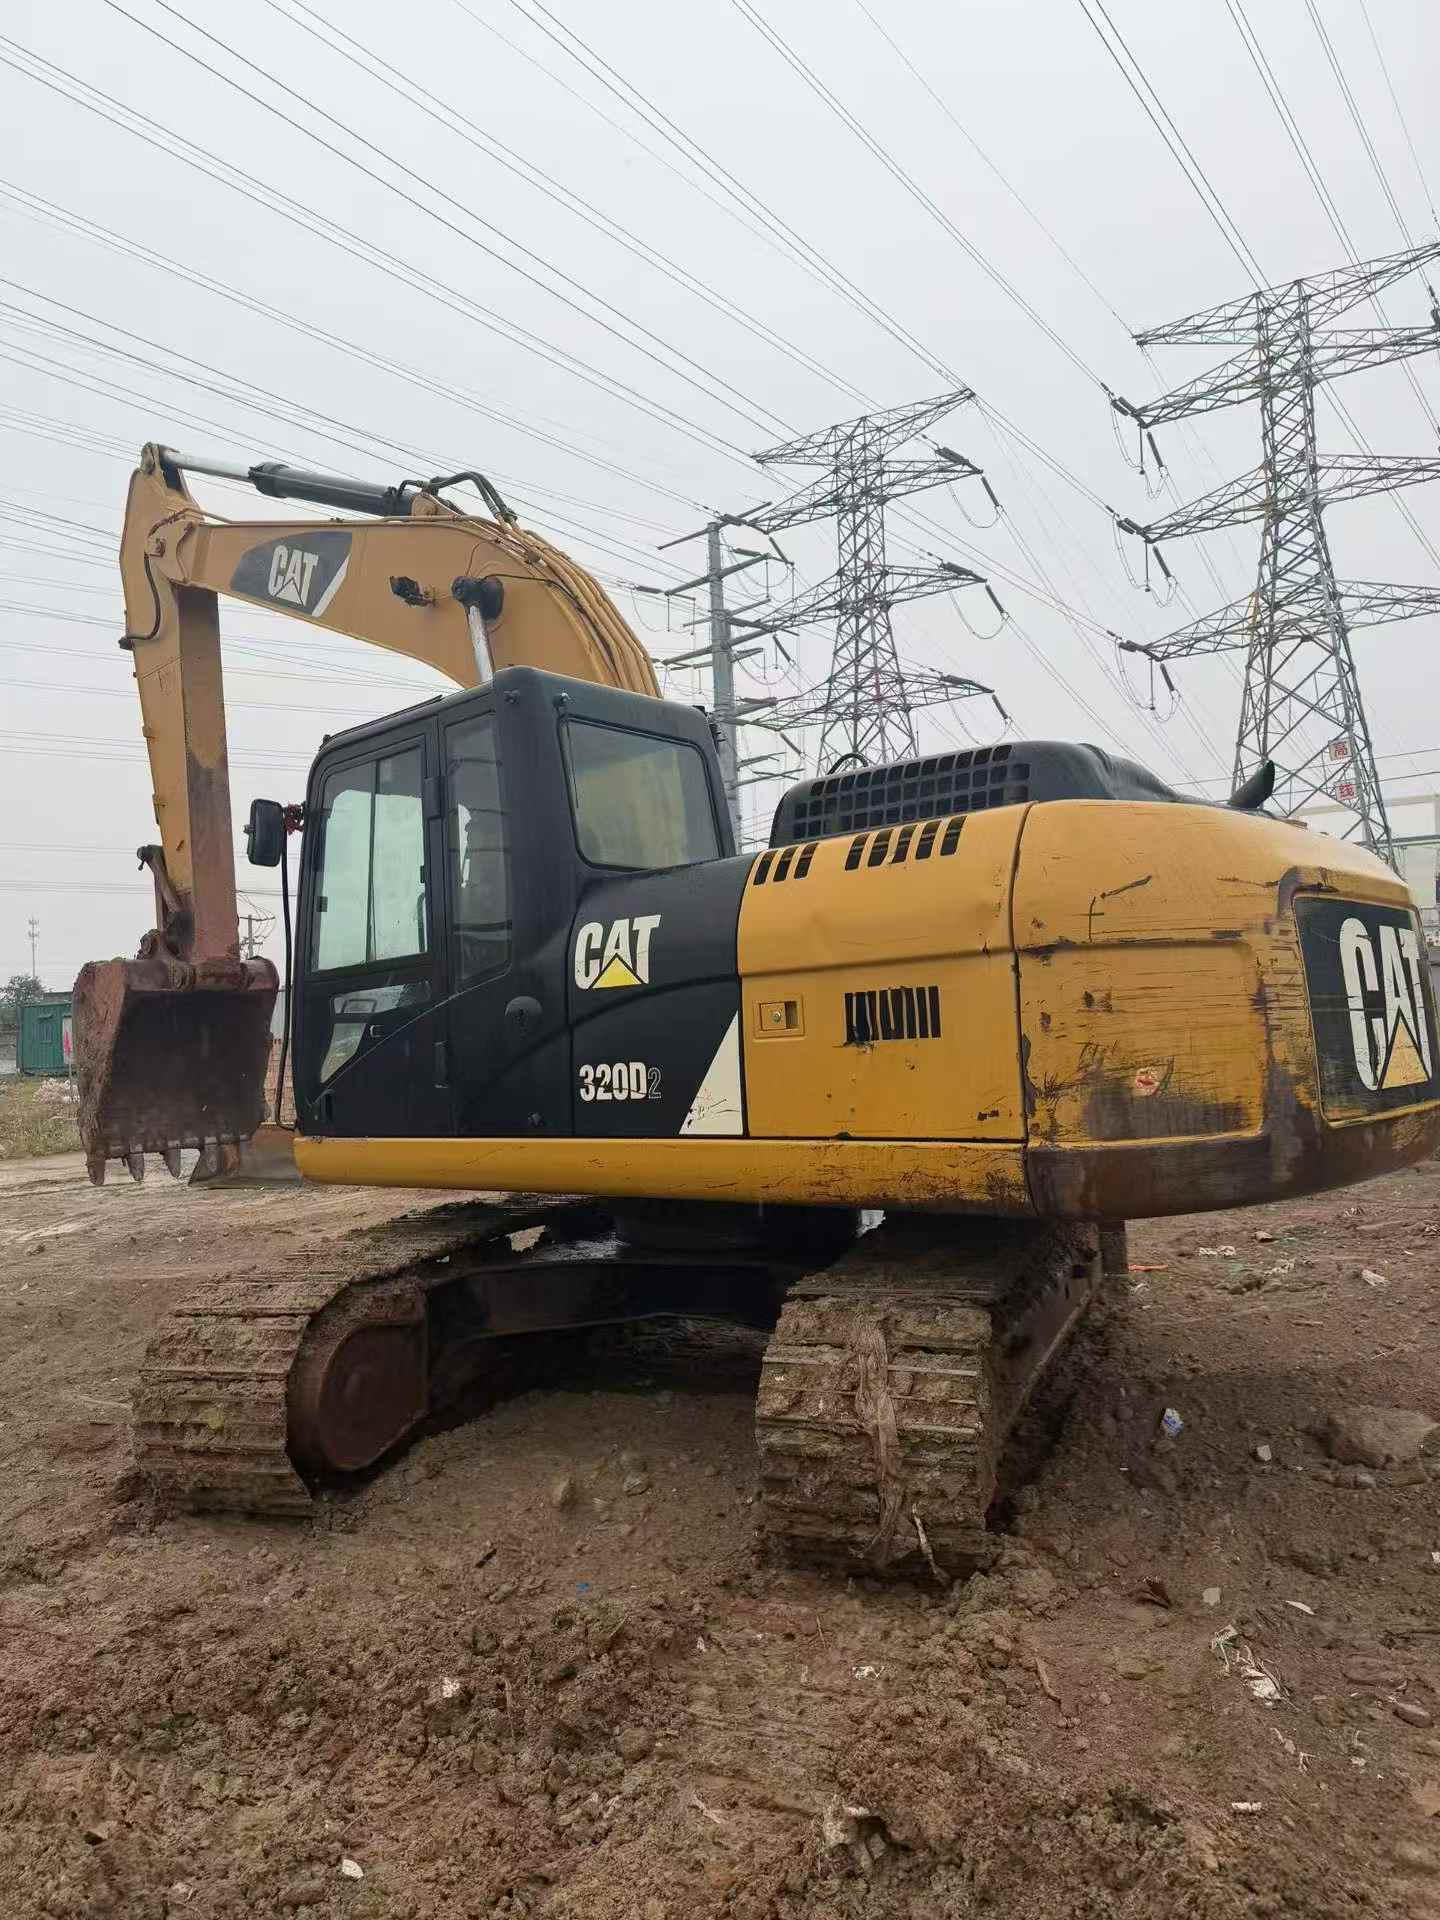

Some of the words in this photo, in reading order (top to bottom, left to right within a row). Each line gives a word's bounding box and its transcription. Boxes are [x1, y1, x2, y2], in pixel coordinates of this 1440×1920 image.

[268, 545, 319, 607] CAT
[574, 914, 662, 990] CAT
[1339, 917, 1433, 1091] CAT
[578, 1061, 662, 1102] 320D2
